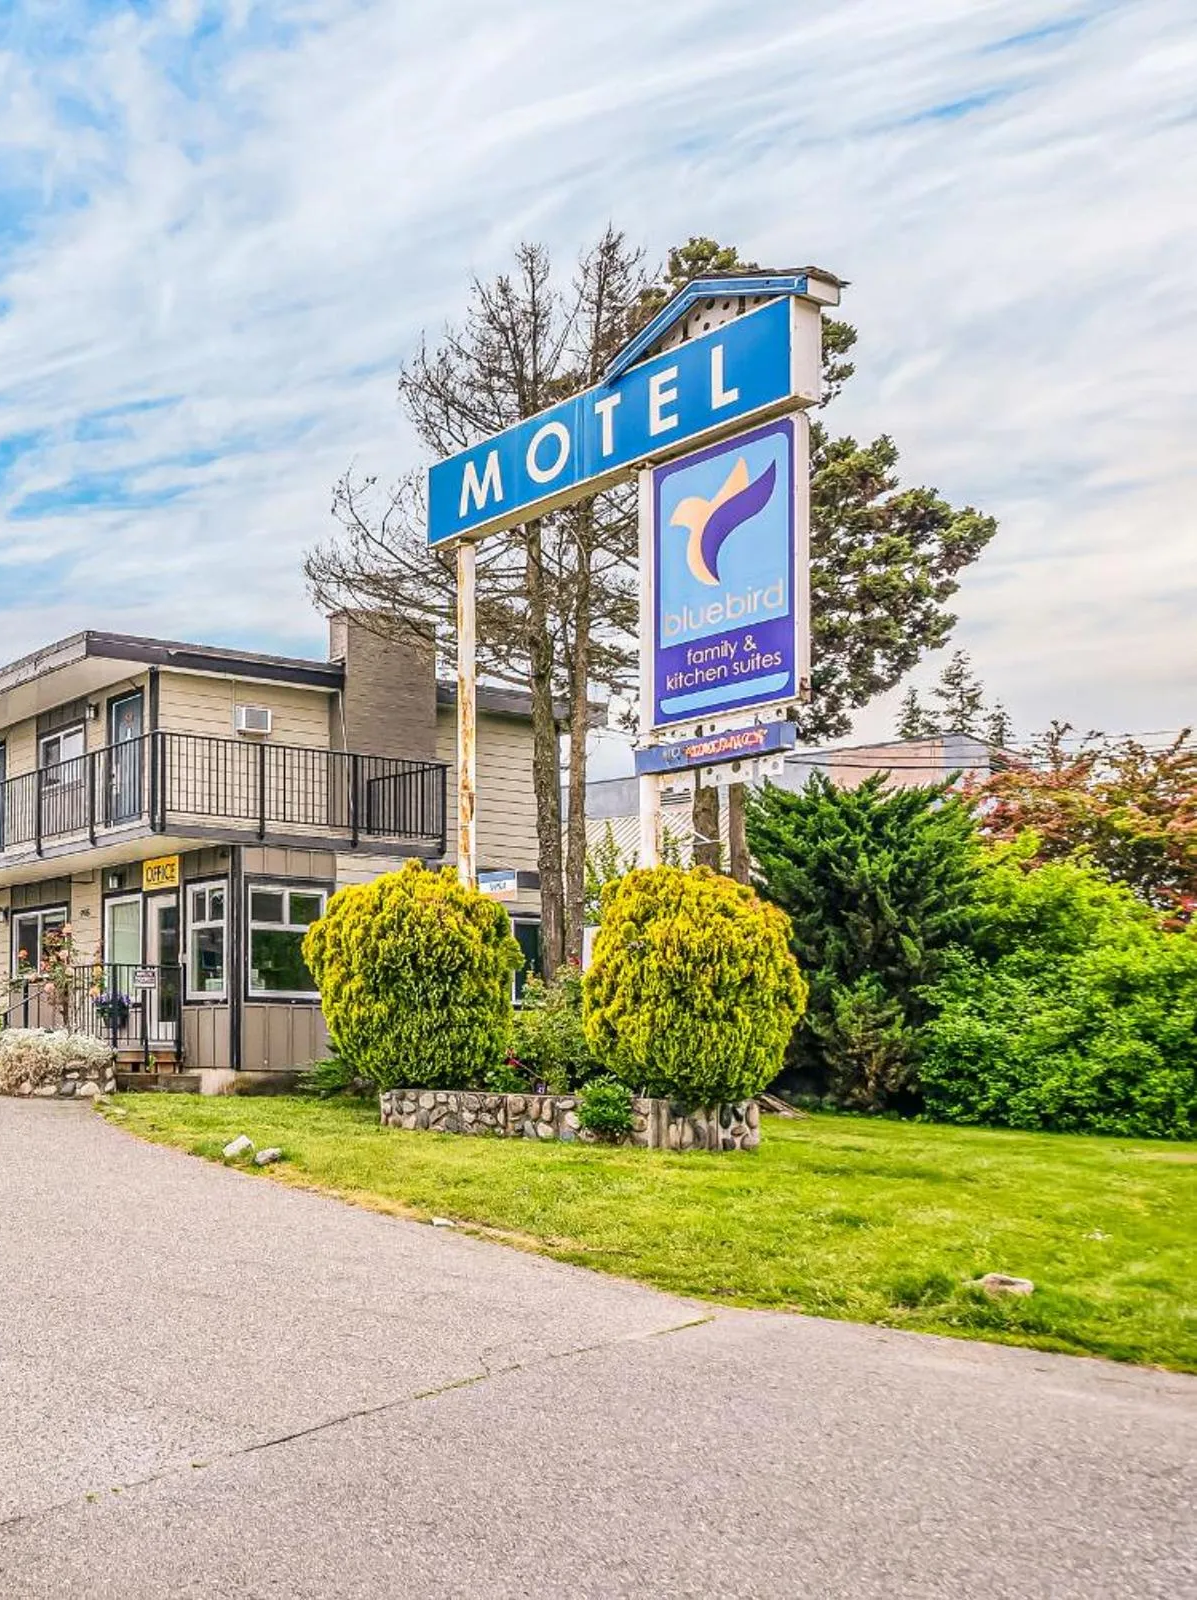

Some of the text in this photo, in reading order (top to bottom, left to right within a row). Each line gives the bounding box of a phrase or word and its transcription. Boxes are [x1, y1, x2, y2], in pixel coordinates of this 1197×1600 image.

[459, 344, 739, 518] MOTEL
[664, 577, 783, 637] bluebird
[666, 651, 782, 691] kitchen suites
[687, 634, 757, 665] family &
